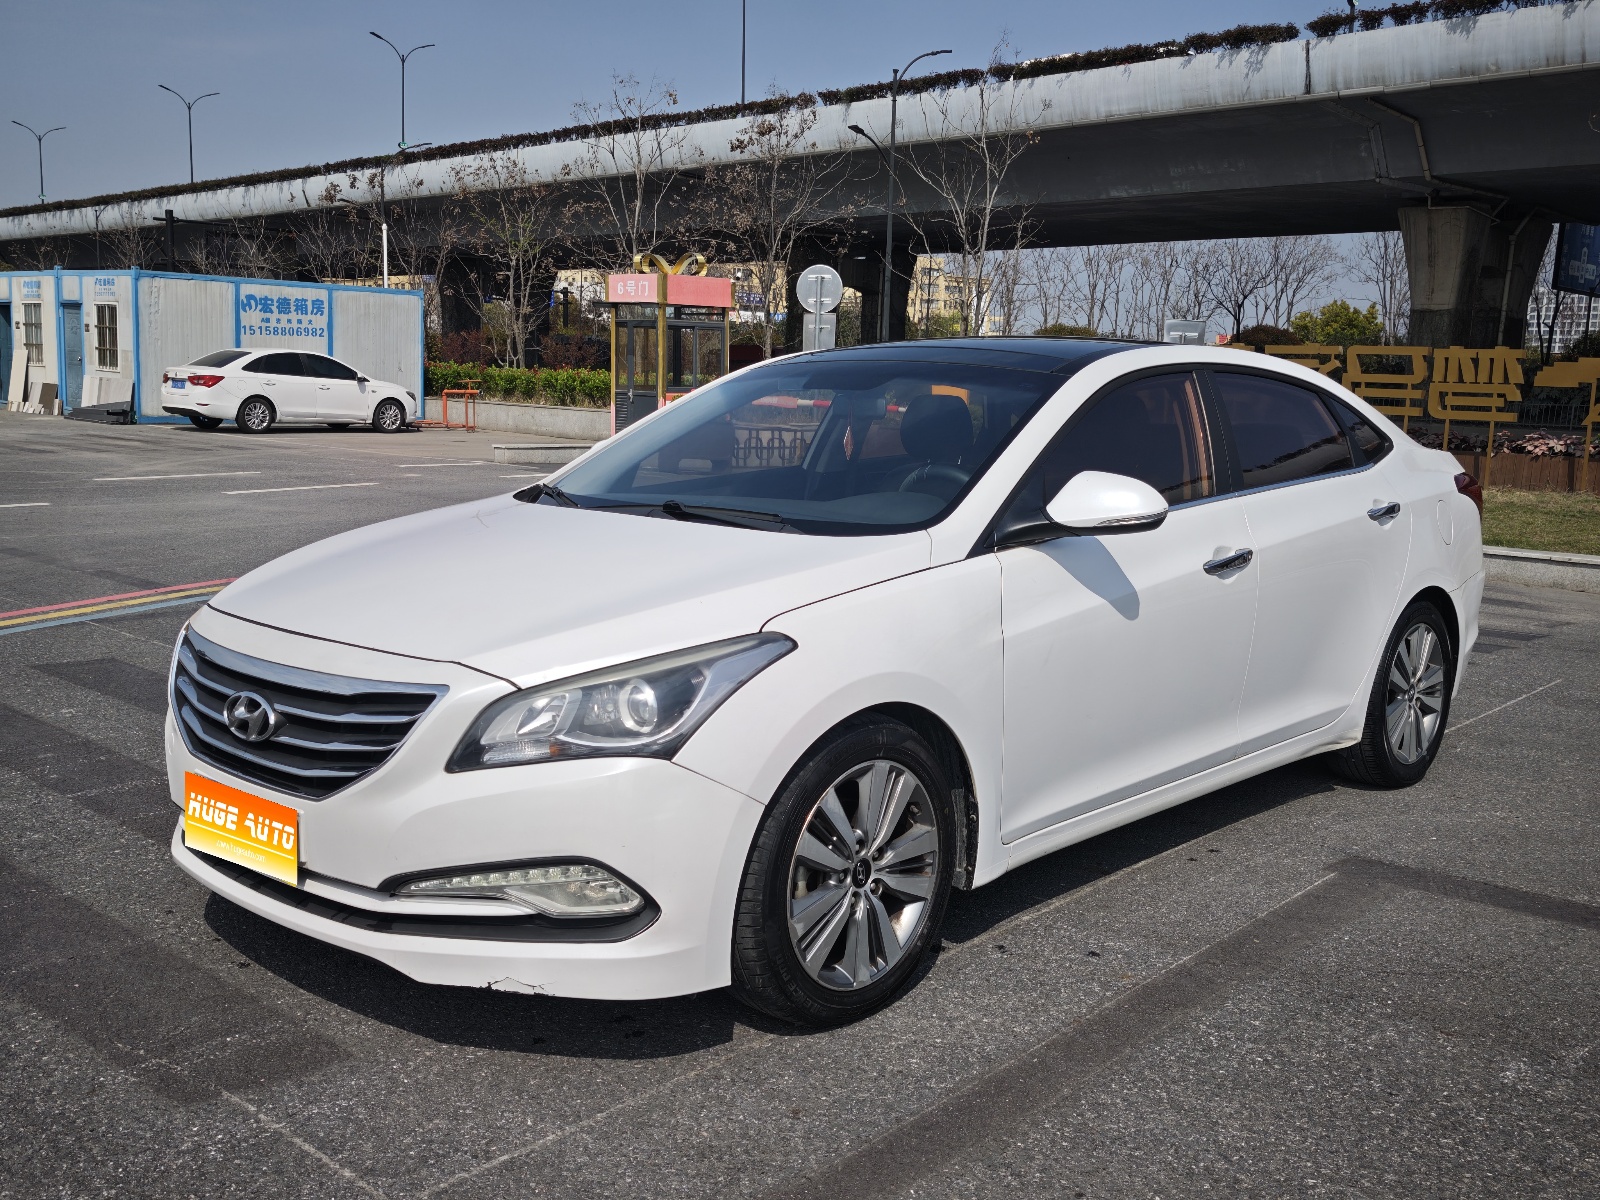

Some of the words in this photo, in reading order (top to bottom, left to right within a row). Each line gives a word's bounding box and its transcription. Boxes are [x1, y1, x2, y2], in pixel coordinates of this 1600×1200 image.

[617, 280, 649, 297] 6号门
[258, 296, 325, 317] 宏德箱房
[242, 325, 325, 338] 15158806982
